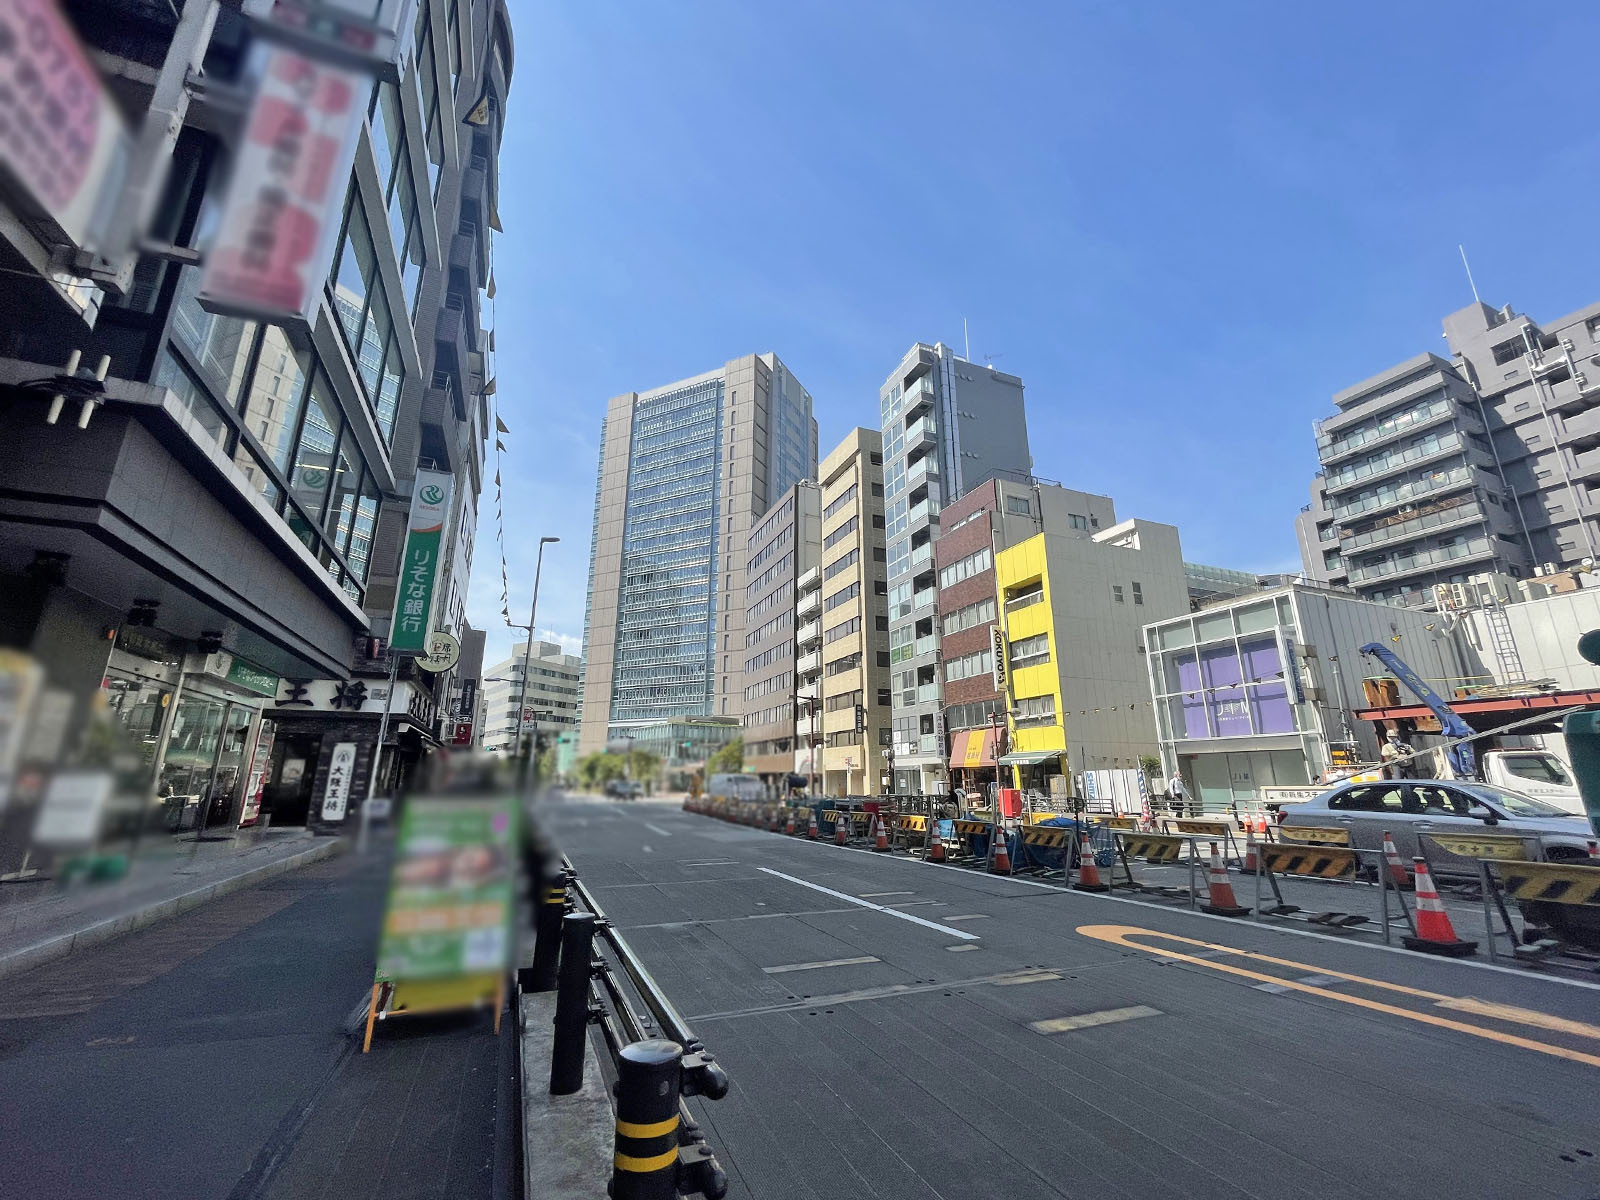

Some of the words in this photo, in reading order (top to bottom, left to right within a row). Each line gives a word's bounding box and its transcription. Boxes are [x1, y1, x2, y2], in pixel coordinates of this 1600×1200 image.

[401, 549, 430, 633] りそな銀行
[994, 629, 1004, 670] KOKUYO
